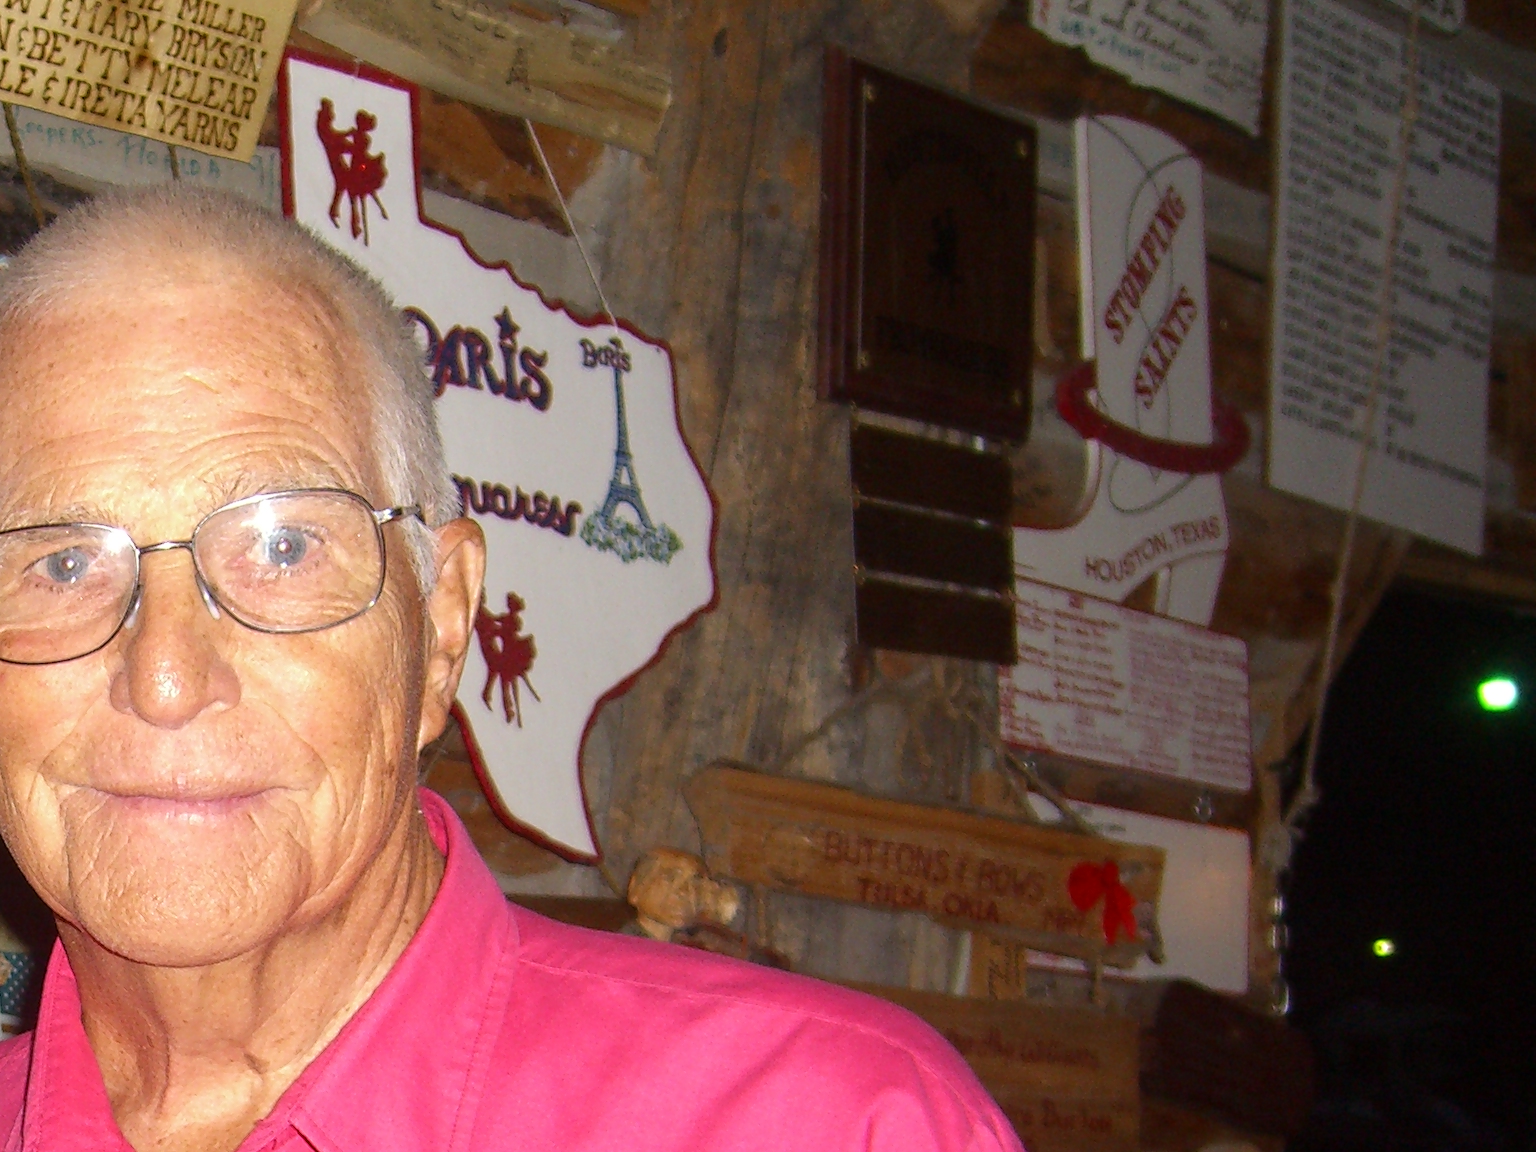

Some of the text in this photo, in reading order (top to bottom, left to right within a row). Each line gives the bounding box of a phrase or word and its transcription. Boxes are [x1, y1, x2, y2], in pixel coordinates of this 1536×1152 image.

[177, 0, 266, 43] MILLER
[166, 24, 267, 82] BRYSON
[58, 77, 148, 128] IRETA
[156, 100, 241, 152] YARNS
[1171, 516, 1221, 545] TEXAS
